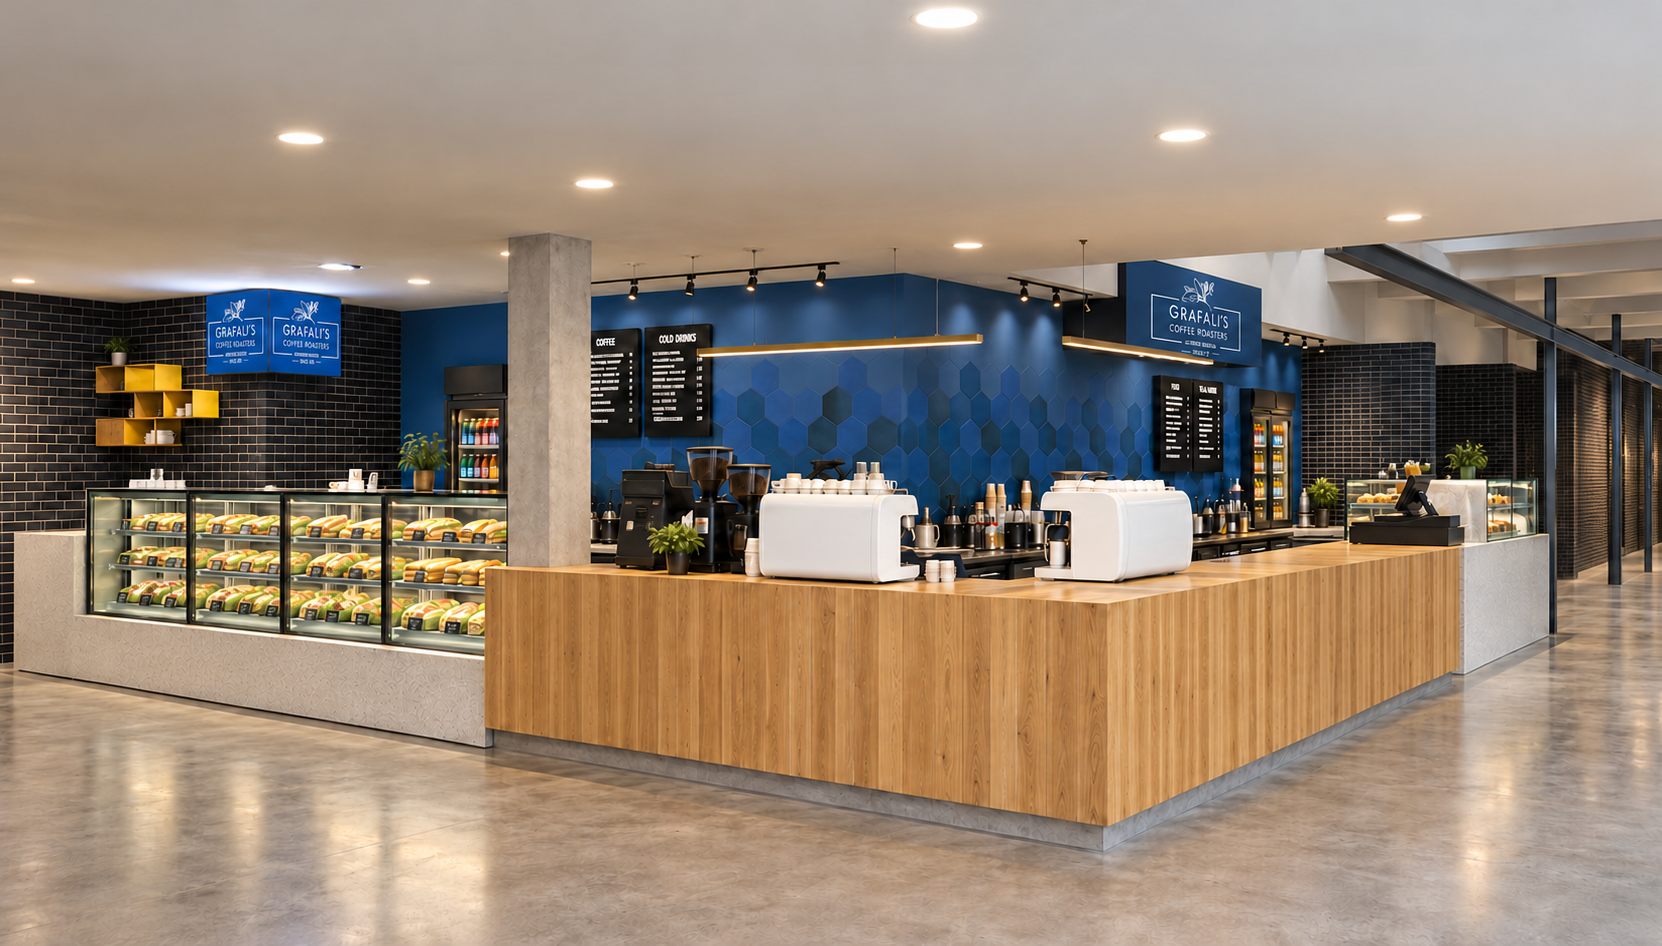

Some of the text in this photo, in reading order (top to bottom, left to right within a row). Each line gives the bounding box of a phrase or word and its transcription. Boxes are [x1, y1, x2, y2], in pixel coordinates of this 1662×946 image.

[1169, 304, 1229, 329] GRAFALI'S
[283, 324, 330, 340] GRAFALI'S
[658, 333, 697, 344] COLD DRINKS
[1169, 324, 1228, 341] COFFEE ROASTERS
[595, 337, 616, 347] COFFEE
